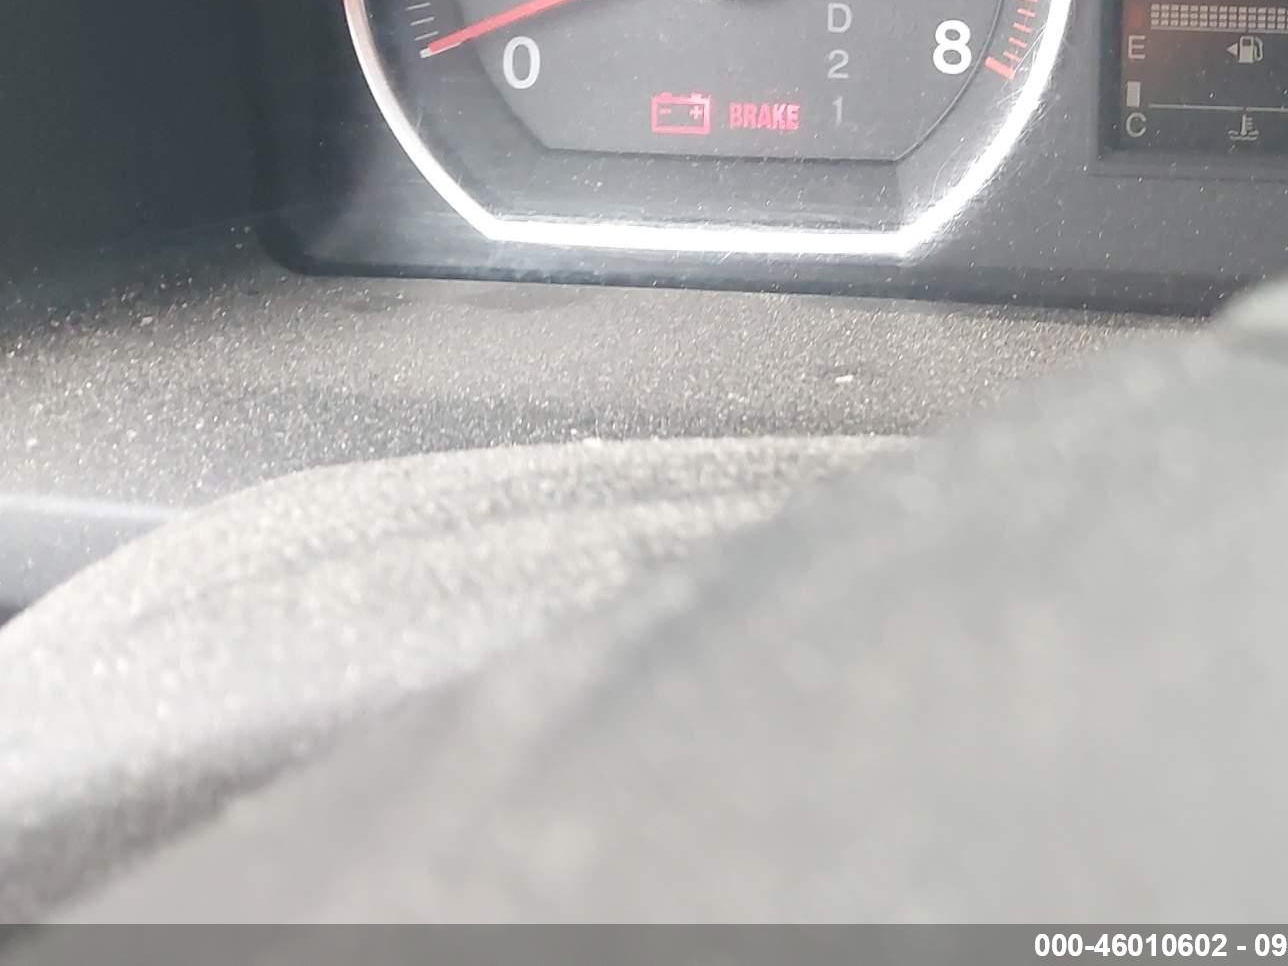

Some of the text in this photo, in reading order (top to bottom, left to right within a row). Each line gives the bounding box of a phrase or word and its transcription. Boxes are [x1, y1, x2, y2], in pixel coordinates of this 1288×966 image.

[827, 2, 853, 34] D
[503, 36, 541, 89] 0
[932, 20, 972, 75] 8
[1127, 35, 1146, 60] E
[827, 49, 850, 79] 2
[729, 101, 801, 131] BRAKE
[830, 96, 843, 124] 1
[1125, 112, 1147, 138] C
